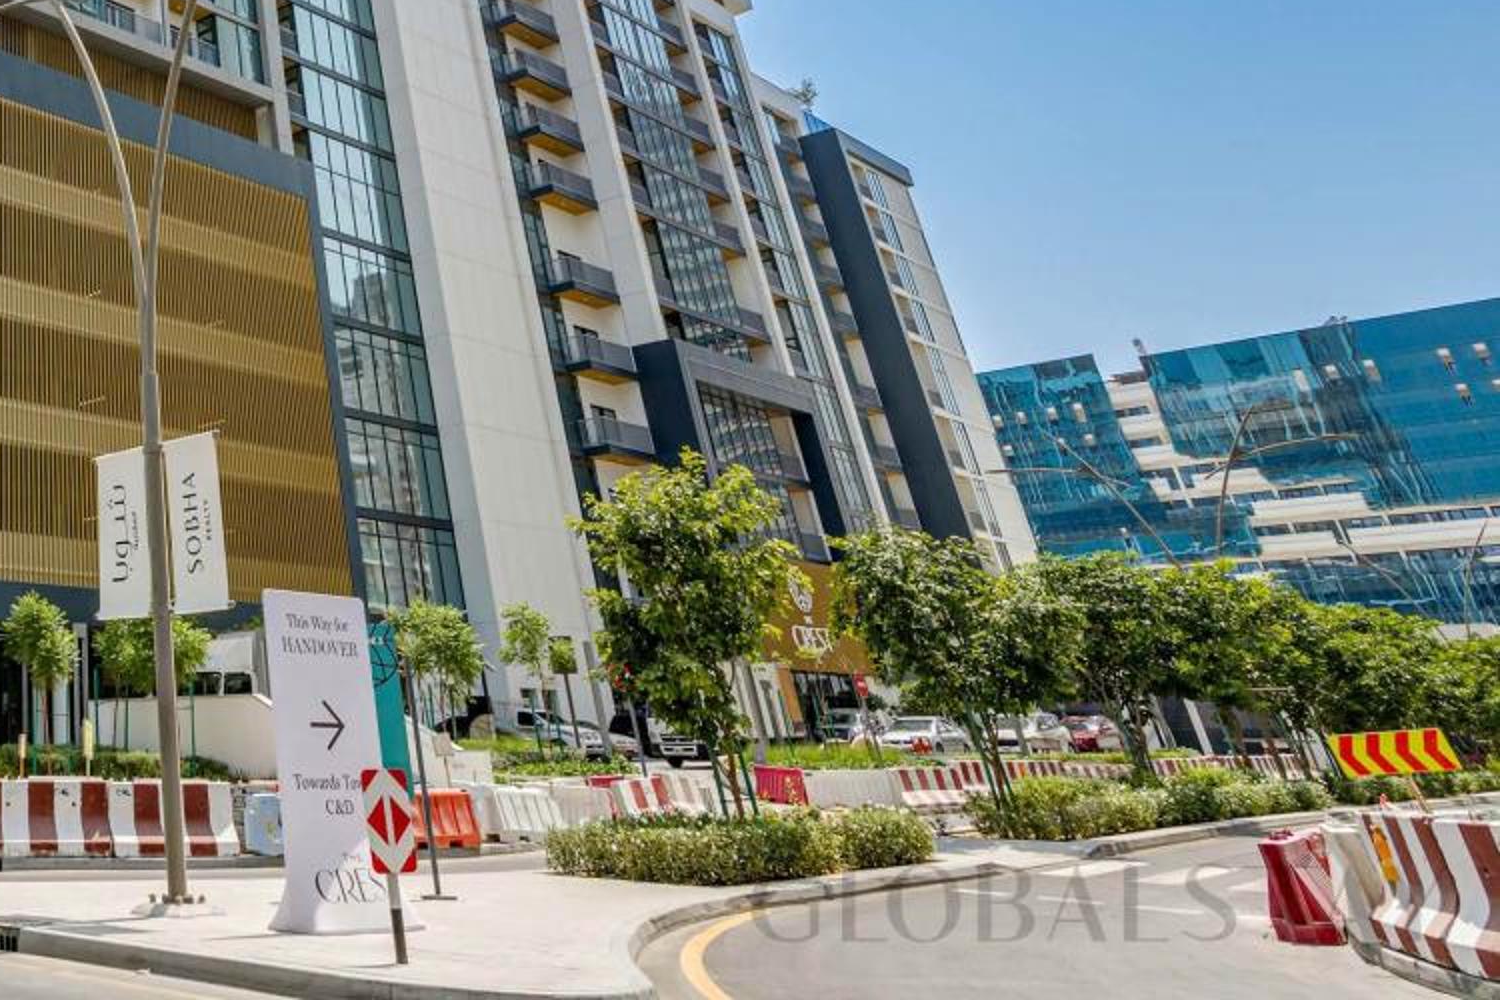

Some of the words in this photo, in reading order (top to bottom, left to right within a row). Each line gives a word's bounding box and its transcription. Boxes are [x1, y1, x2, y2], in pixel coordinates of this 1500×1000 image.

[182, 472, 204, 575] SOBHA
[285, 613, 309, 629] This
[310, 615, 332, 635] Way
[282, 635, 357, 657] HANDOVER
[292, 773, 340, 790] Towards
[325, 799, 355, 815] C&D
